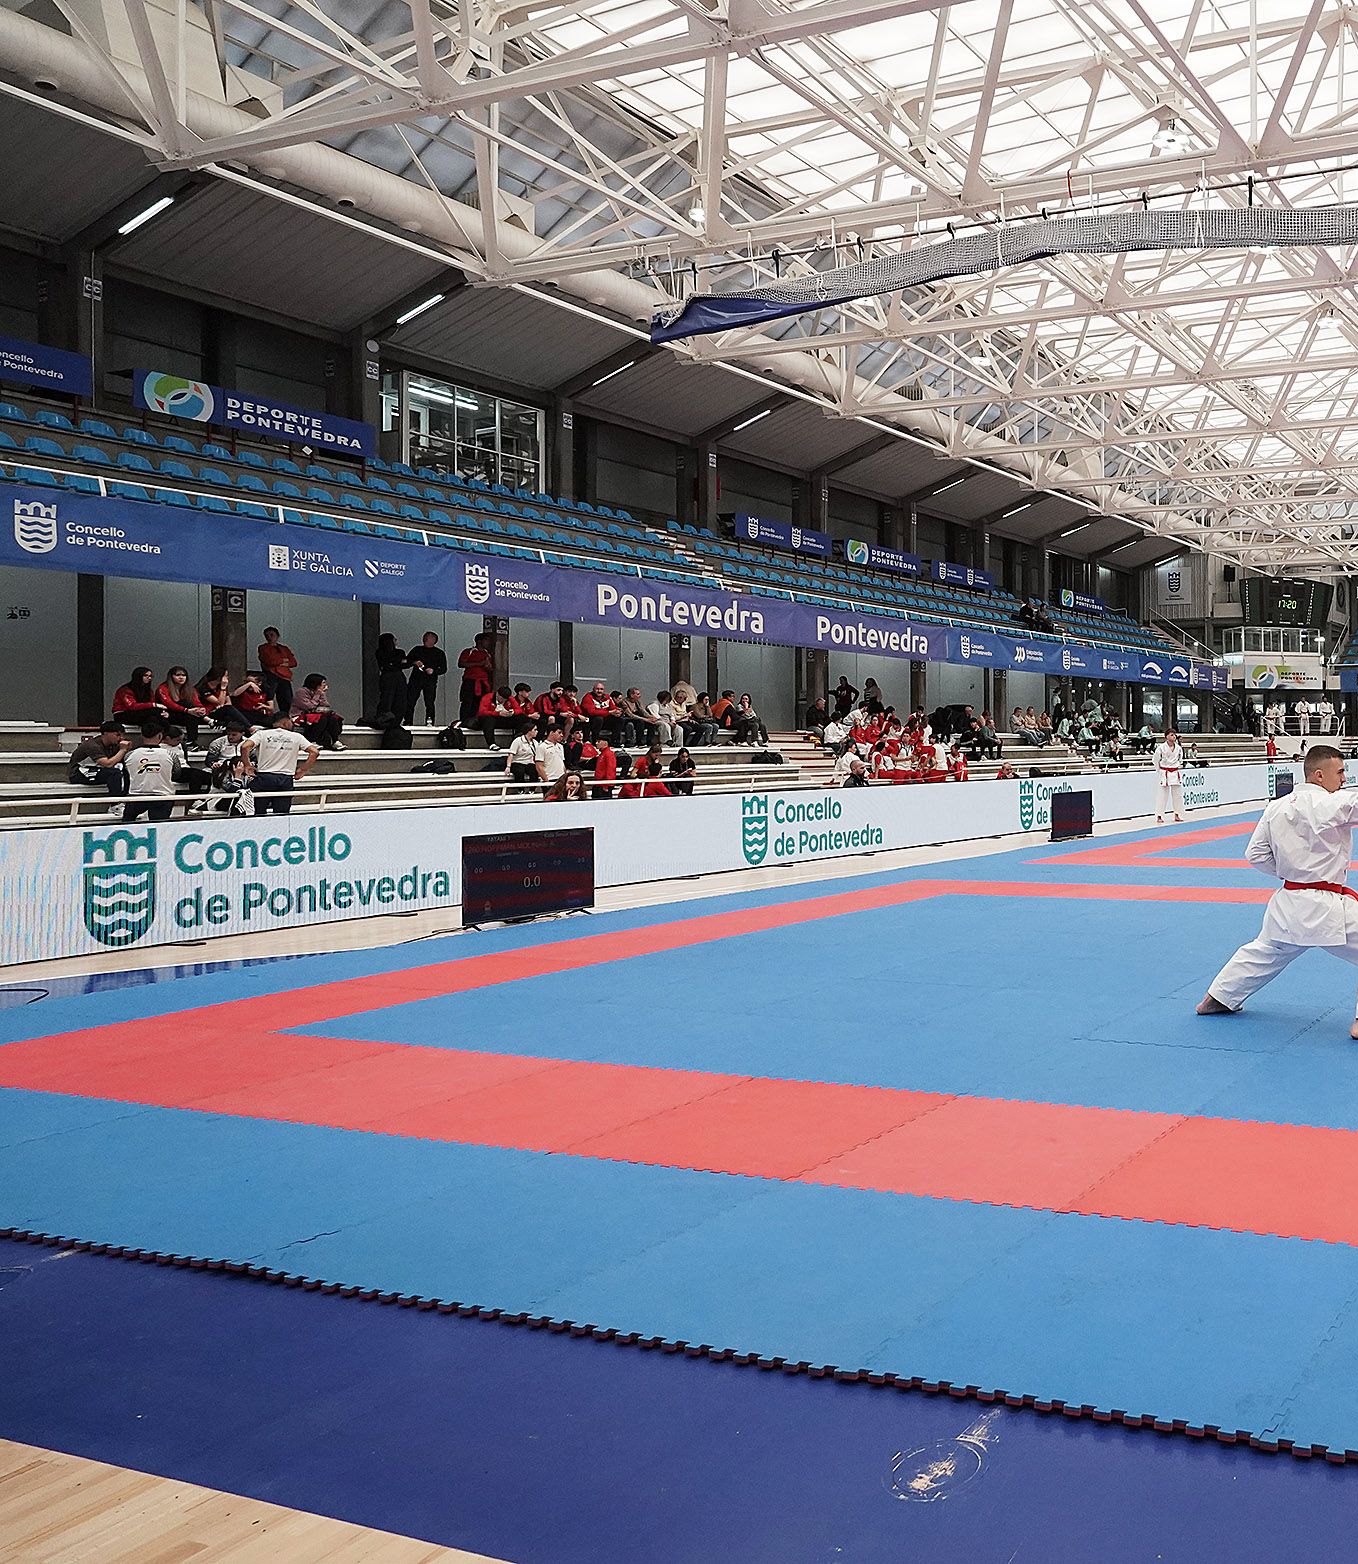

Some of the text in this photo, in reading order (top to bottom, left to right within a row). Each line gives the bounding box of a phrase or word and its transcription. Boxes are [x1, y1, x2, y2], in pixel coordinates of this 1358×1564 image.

[0, 350, 34, 364] ncello
[3, 360, 64, 380] Pontevedra
[227, 398, 322, 429] DEPORTE
[227, 410, 362, 449] PONTEVEDRA
[66, 522, 125, 538] Concello
[66, 534, 161, 554] de Pontevedra
[292, 549, 331, 564] XUNTA
[871, 549, 903, 562] DEPORTE
[292, 561, 354, 577] DE GALICIA
[380, 561, 406, 570] DEPORTE
[871, 556, 917, 571] PONTEVEDRA
[380, 568, 405, 577] GALEGO
[494, 578, 528, 590] Concello
[230, 595, 242, 607] C
[494, 588, 550, 602] de Pontevedra
[597, 584, 765, 634] Pontevedra
[1278, 600, 1297, 609] 17:20
[498, 620, 507, 630] C
[816, 615, 929, 655] Pontevedra
[1182, 773, 1205, 788] Concello
[1190, 789, 1219, 804] Pontevedra
[774, 797, 842, 824] Concello
[1036, 807, 1048, 825] de
[774, 823, 883, 857] de Pontevedra
[174, 826, 351, 874] Concello
[523, 875, 541, 888] 0.0
[174, 865, 450, 929] de Pontevedra
